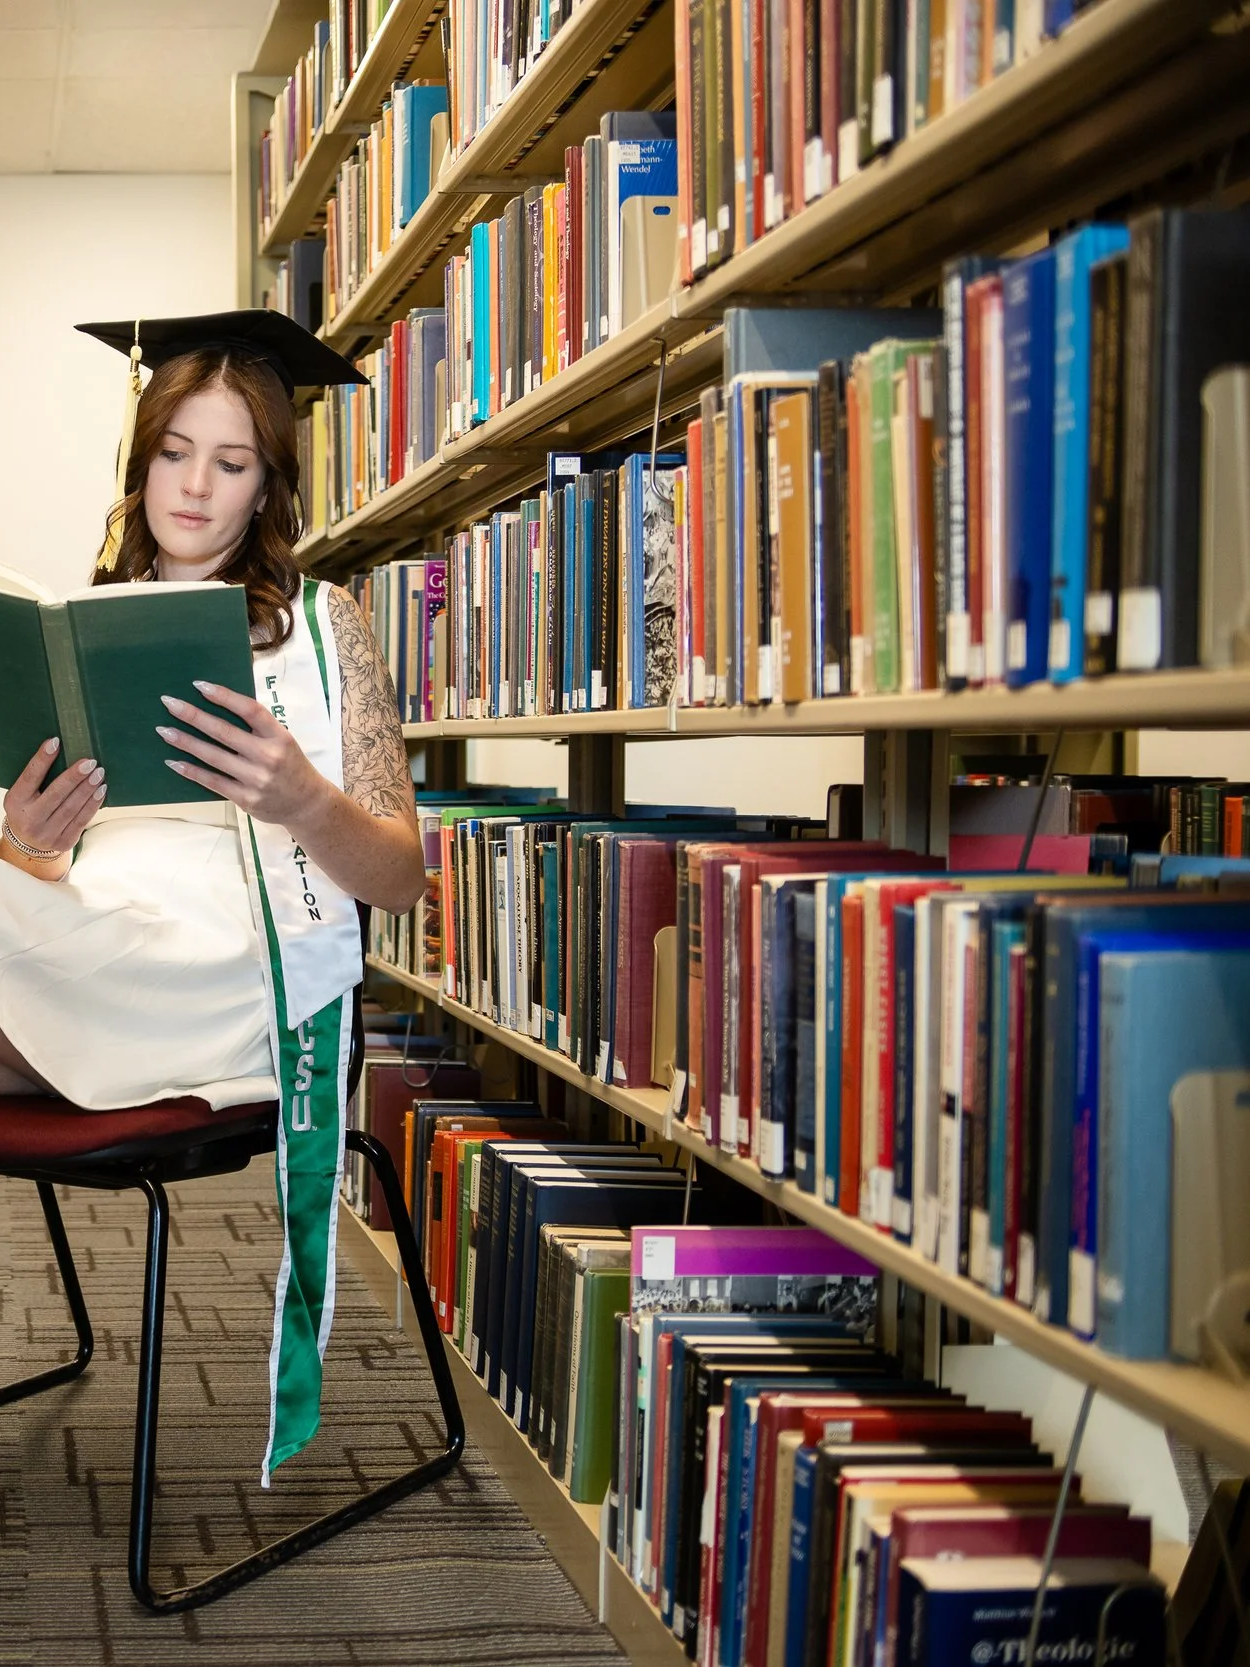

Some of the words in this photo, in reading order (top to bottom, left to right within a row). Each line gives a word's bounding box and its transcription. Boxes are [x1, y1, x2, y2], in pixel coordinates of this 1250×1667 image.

[621, 164, 650, 174] Wendel
[640, 156, 663, 164] mann-
[602, 571, 608, 595] ON
[265, 675, 289, 730] FIR
[878, 994, 888, 1054] CASES
[291, 1016, 315, 1131] CSU
[572, 1358, 577, 1367] of
